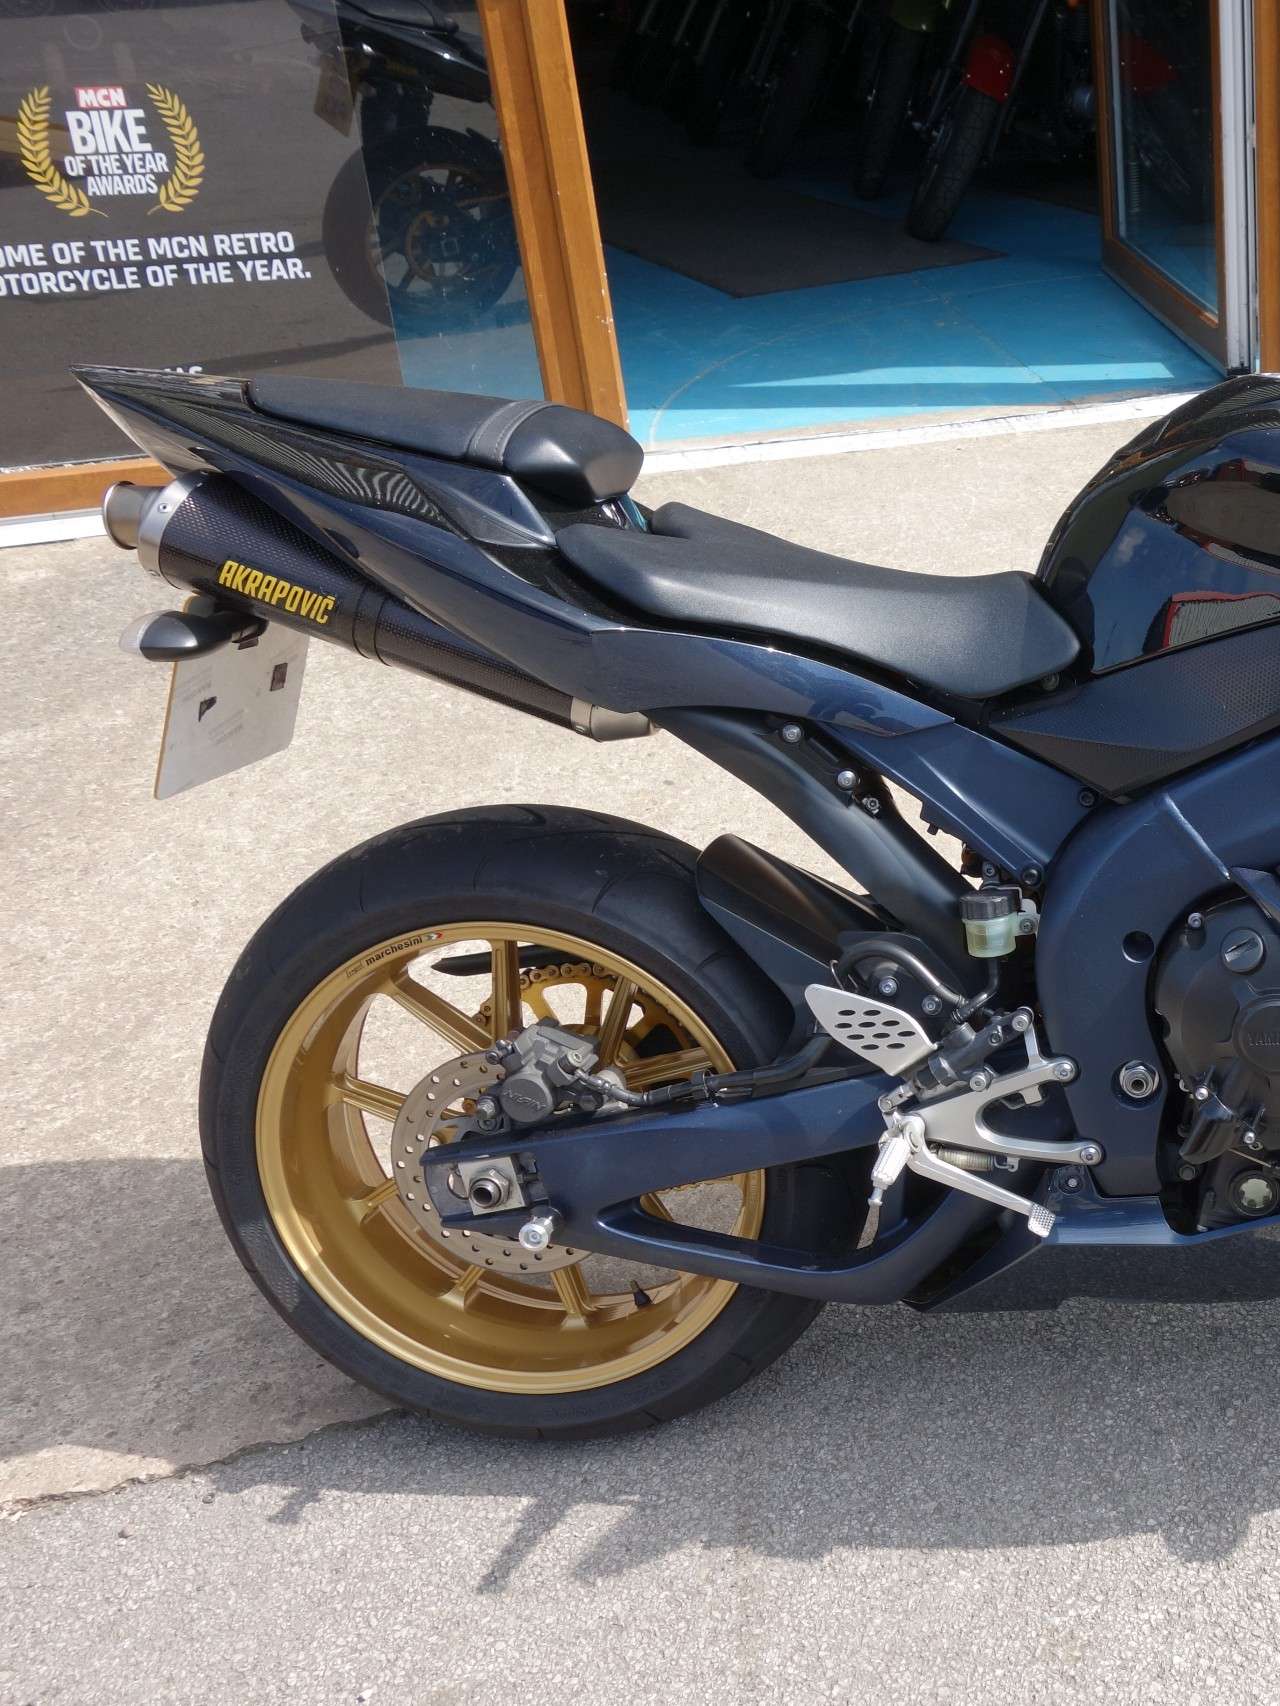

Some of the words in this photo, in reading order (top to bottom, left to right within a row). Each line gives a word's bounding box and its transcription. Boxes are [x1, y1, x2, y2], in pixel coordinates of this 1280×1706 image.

[78, 88, 127, 107] MCN
[65, 109, 153, 154] BIKE
[64, 156, 87, 176] OF
[88, 154, 123, 176] THE
[121, 152, 170, 175] YEAR
[87, 173, 158, 196] AWARDS
[51, 242, 86, 265] OF
[90, 239, 143, 262] THE
[147, 235, 209, 260] MCN
[213, 231, 295, 256] RETRO
[145, 264, 178, 287] OF
[182, 261, 234, 285] THE
[236, 257, 312, 282] YEAR.
[364, 935, 424, 967] marchesini
